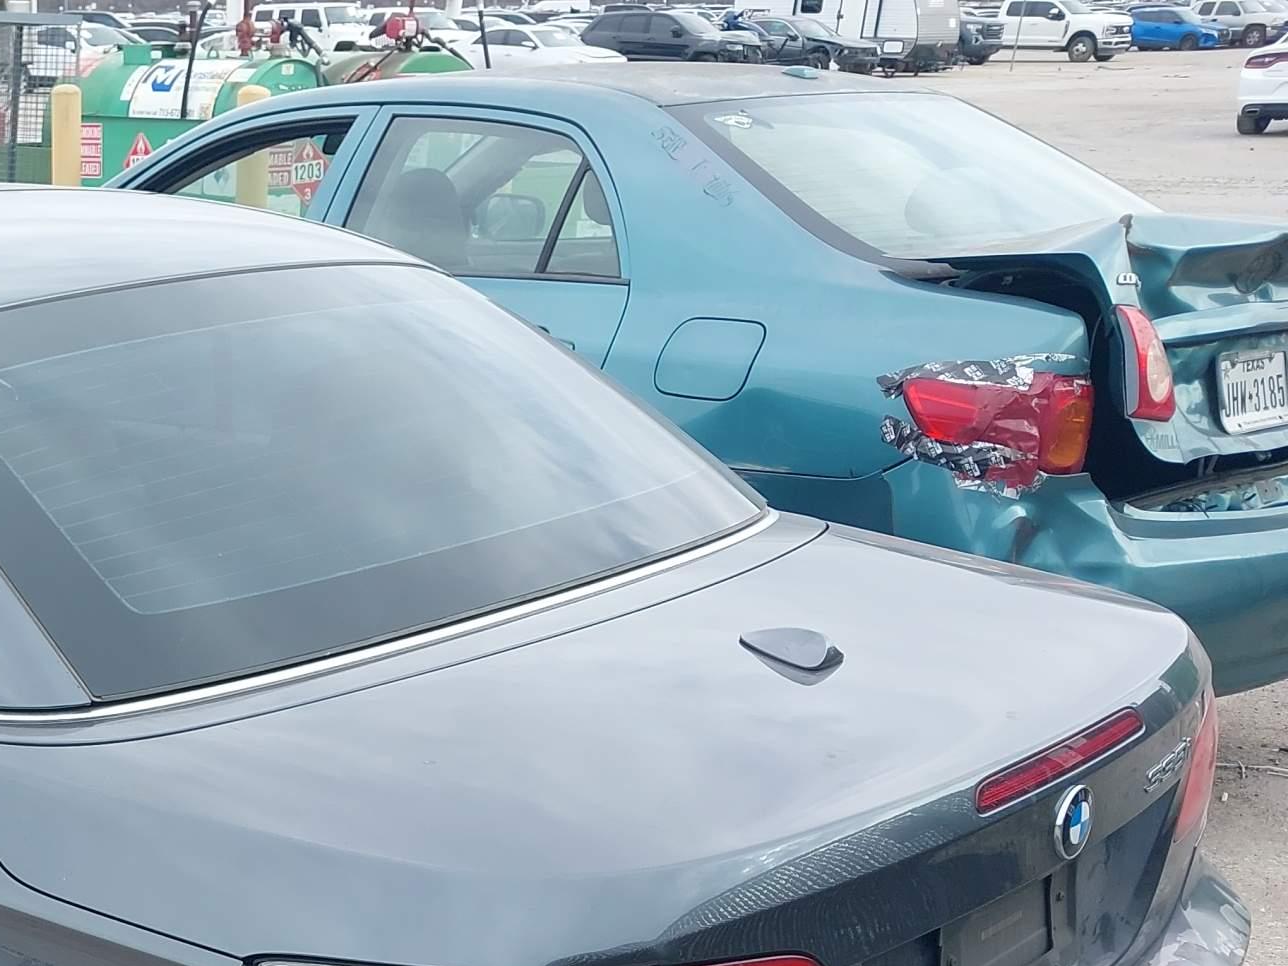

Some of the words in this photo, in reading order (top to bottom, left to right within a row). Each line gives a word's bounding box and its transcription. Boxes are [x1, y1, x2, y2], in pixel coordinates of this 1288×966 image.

[294, 162, 322, 180] 1203
[304, 188, 312, 200] 3
[1242, 360, 1265, 373] TEXAS
